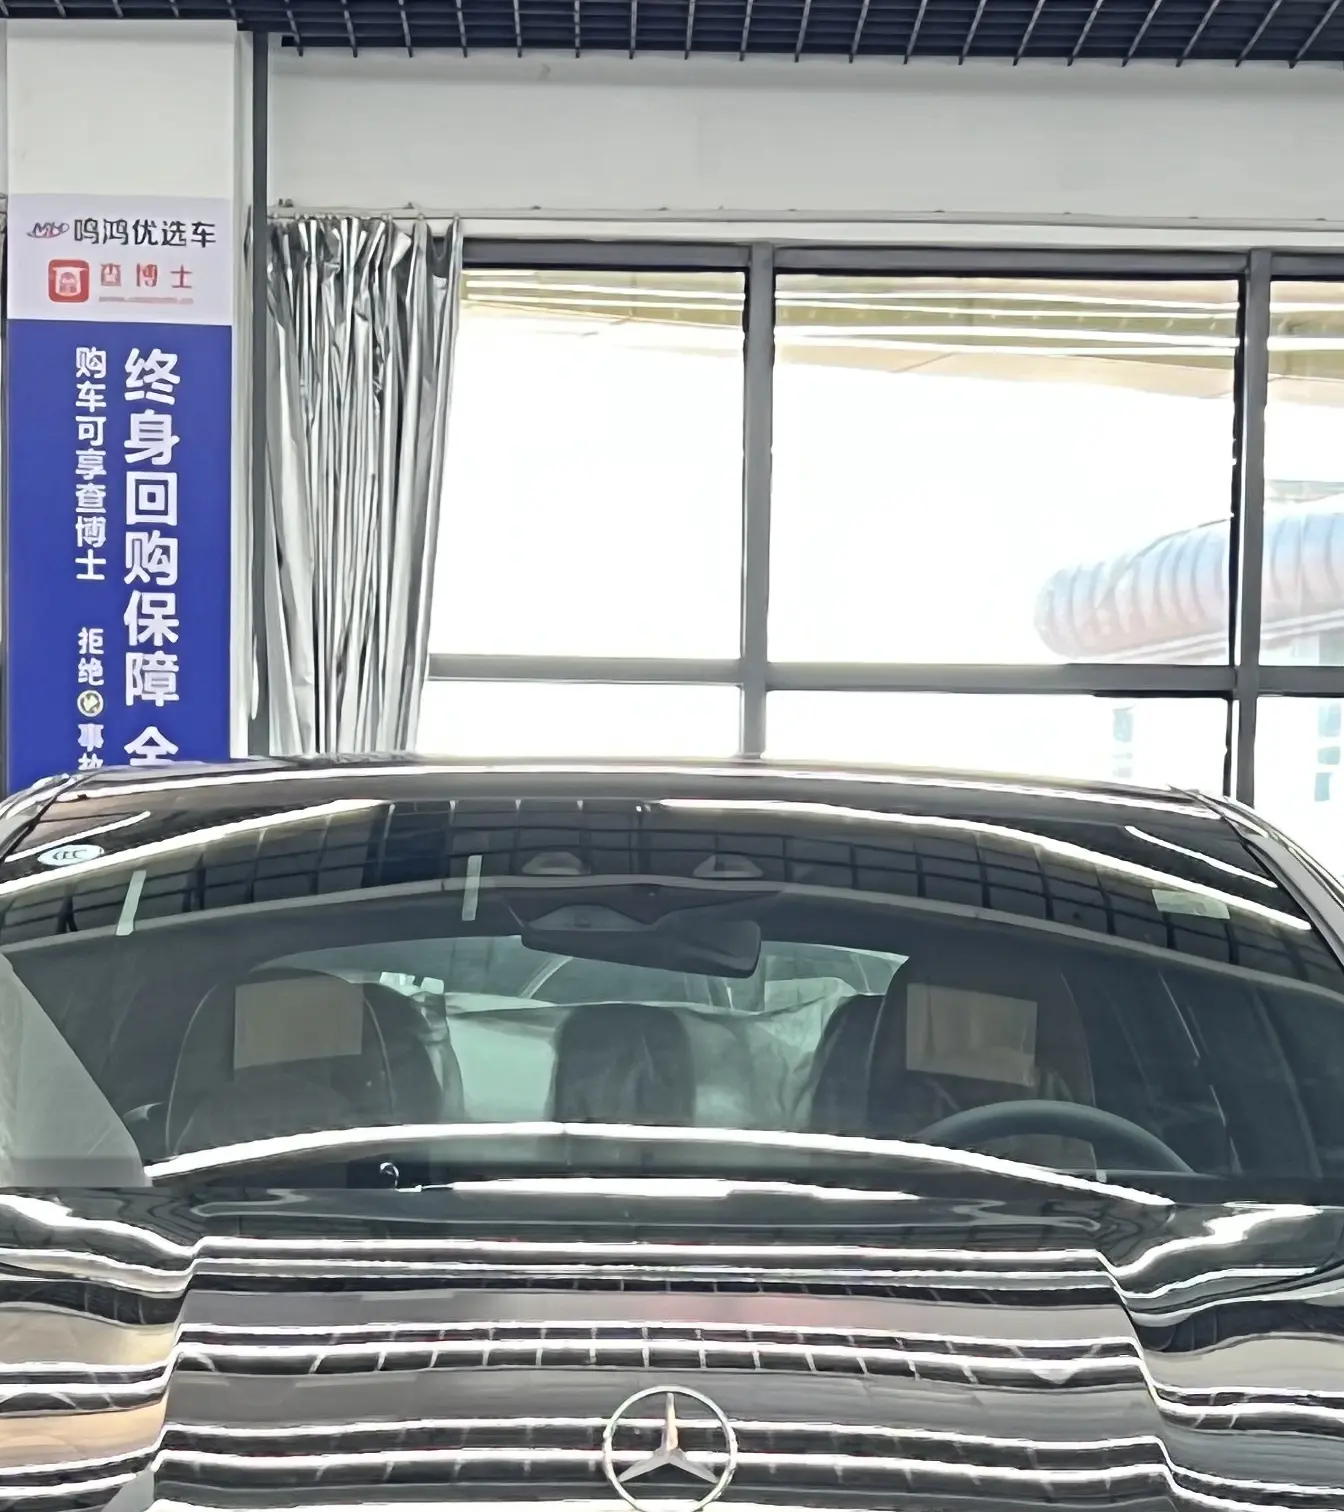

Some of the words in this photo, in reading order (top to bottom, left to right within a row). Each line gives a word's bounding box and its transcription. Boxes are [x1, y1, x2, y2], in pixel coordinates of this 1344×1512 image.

[73, 217, 217, 248] 鸣鸿优选车
[75, 346, 107, 581] 购车可享查博士
[123, 347, 181, 707] 终身回购保障
